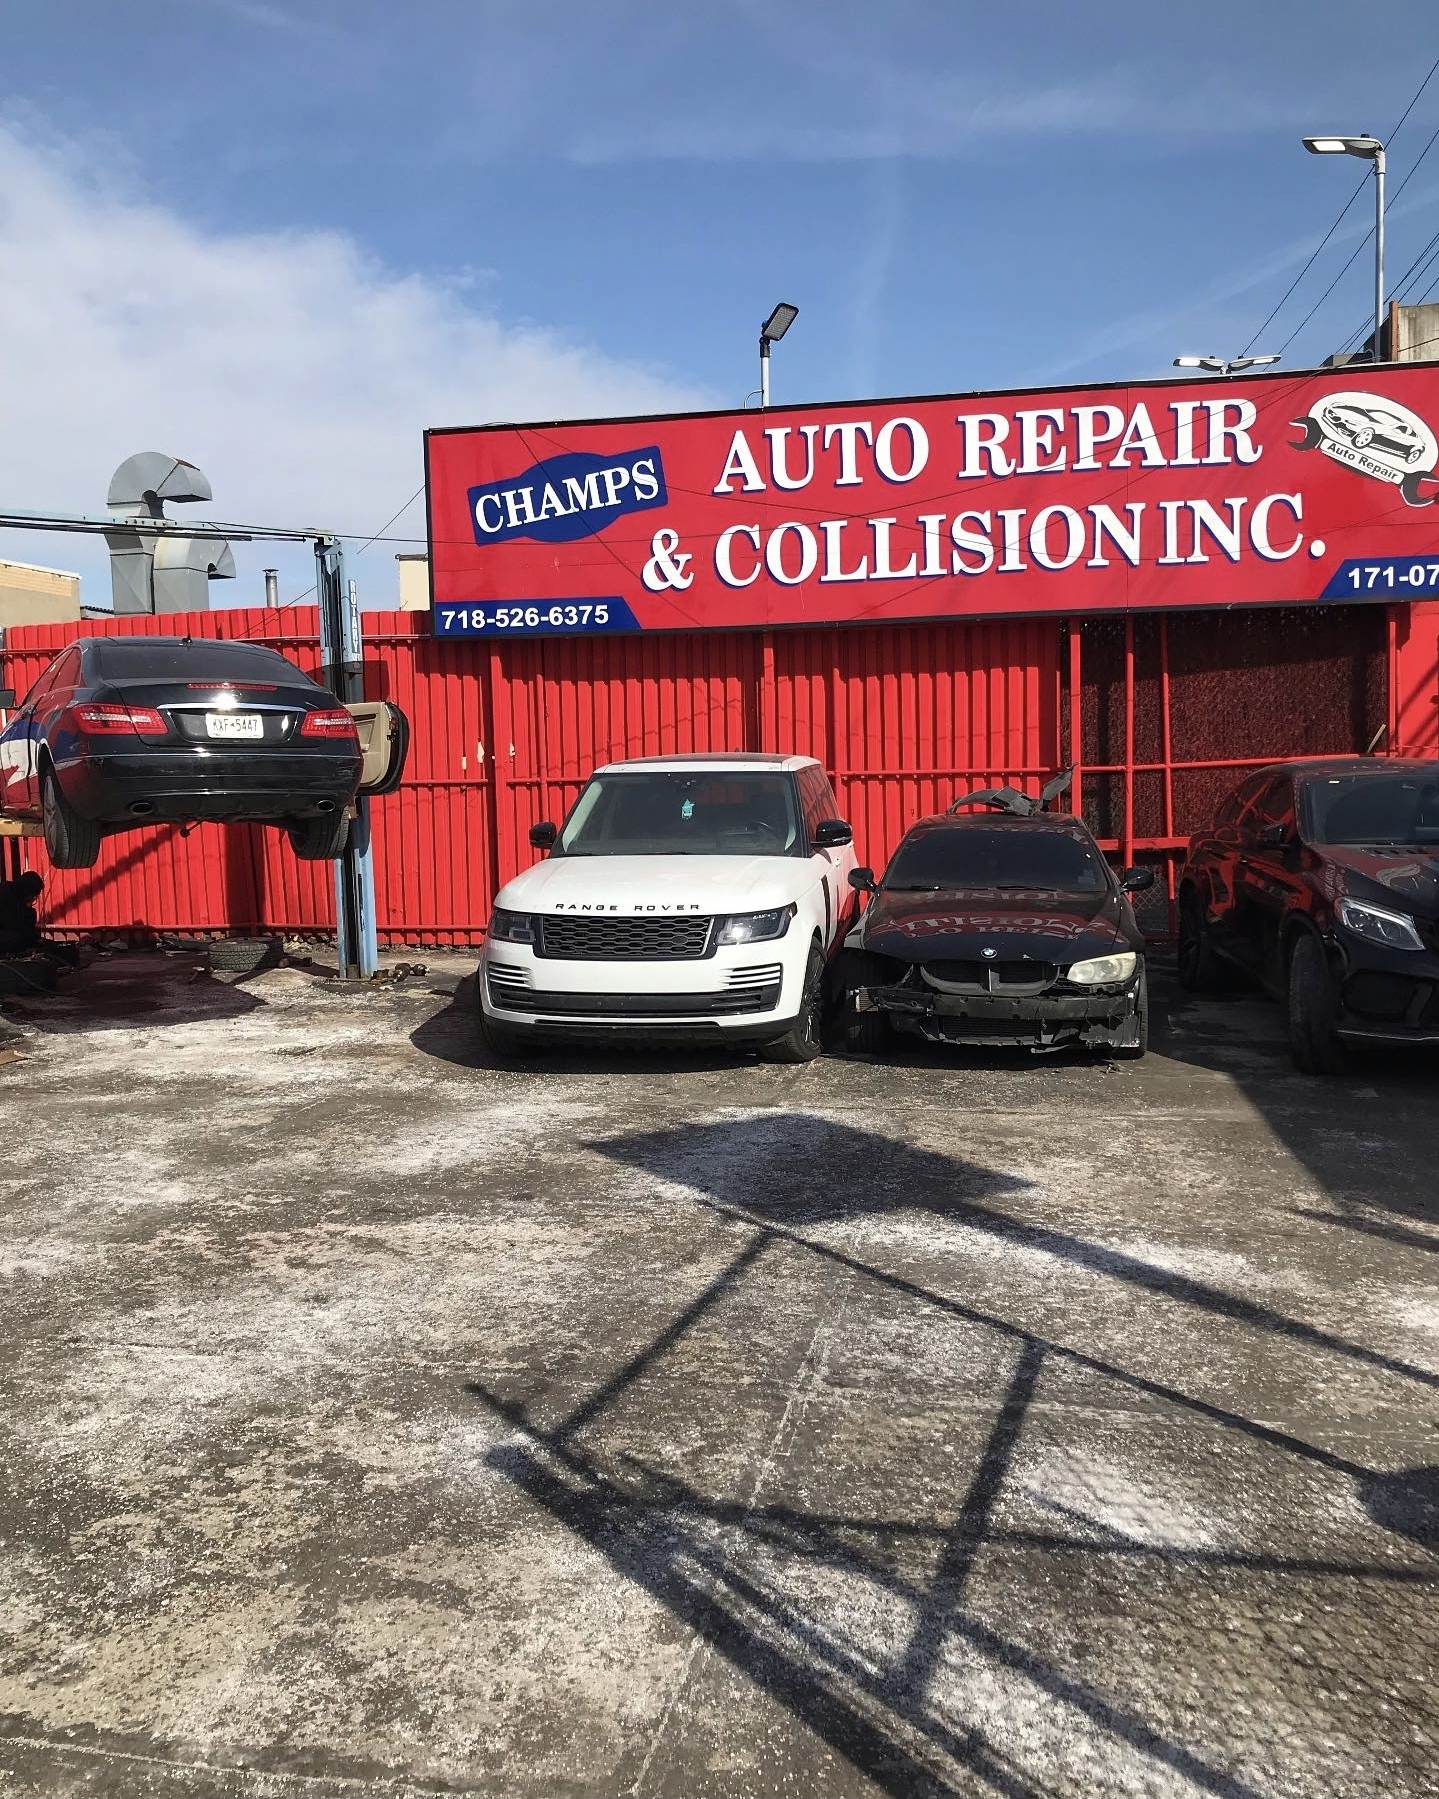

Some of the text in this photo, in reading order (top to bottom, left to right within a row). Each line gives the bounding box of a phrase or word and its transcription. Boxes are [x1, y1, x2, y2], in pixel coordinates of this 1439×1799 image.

[713, 398, 1263, 494] AUTO REPAIR
[1327, 442, 1399, 480] Auto Repair
[474, 458, 660, 534] CHAMPS
[642, 492, 1326, 592] & COLLISION INC.
[1348, 564, 1439, 589] 171-07
[349, 580, 359, 654] ROTARY
[441, 604, 609, 630] 718-526-6375
[555, 903, 618, 911] RANGE
